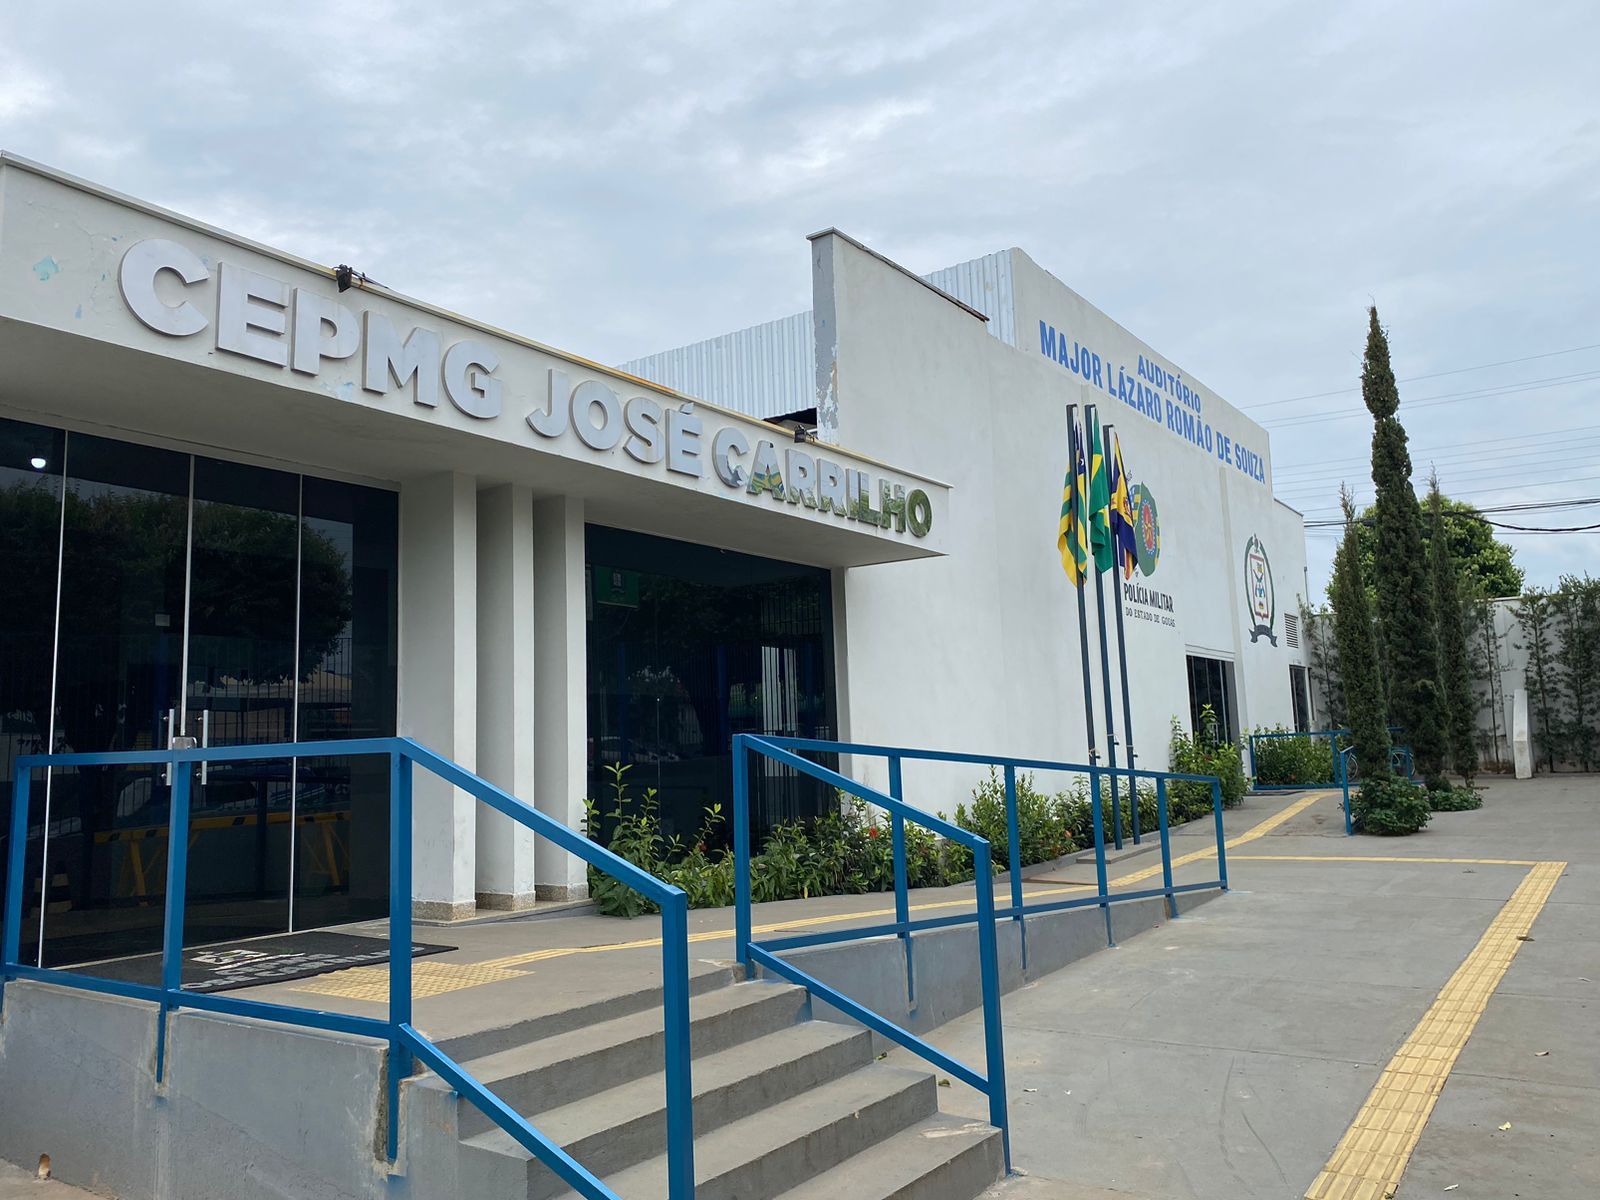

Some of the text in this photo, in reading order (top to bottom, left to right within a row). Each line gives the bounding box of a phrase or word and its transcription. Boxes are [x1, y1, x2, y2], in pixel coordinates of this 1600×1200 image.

[119, 238, 933, 538] CEPMG JOSÉ CARRILHO
[1039, 319, 1266, 485] MAJOR LÁZARO ROMÃO DE SOUZA
[1138, 354, 1201, 413] AUDITÓRIO
[1123, 582, 1174, 613] POLÍCIA MILITAR
[1125, 606, 1133, 617] DO
[1134, 608, 1153, 622] ESTADO
[1153, 613, 1160, 624] DE
